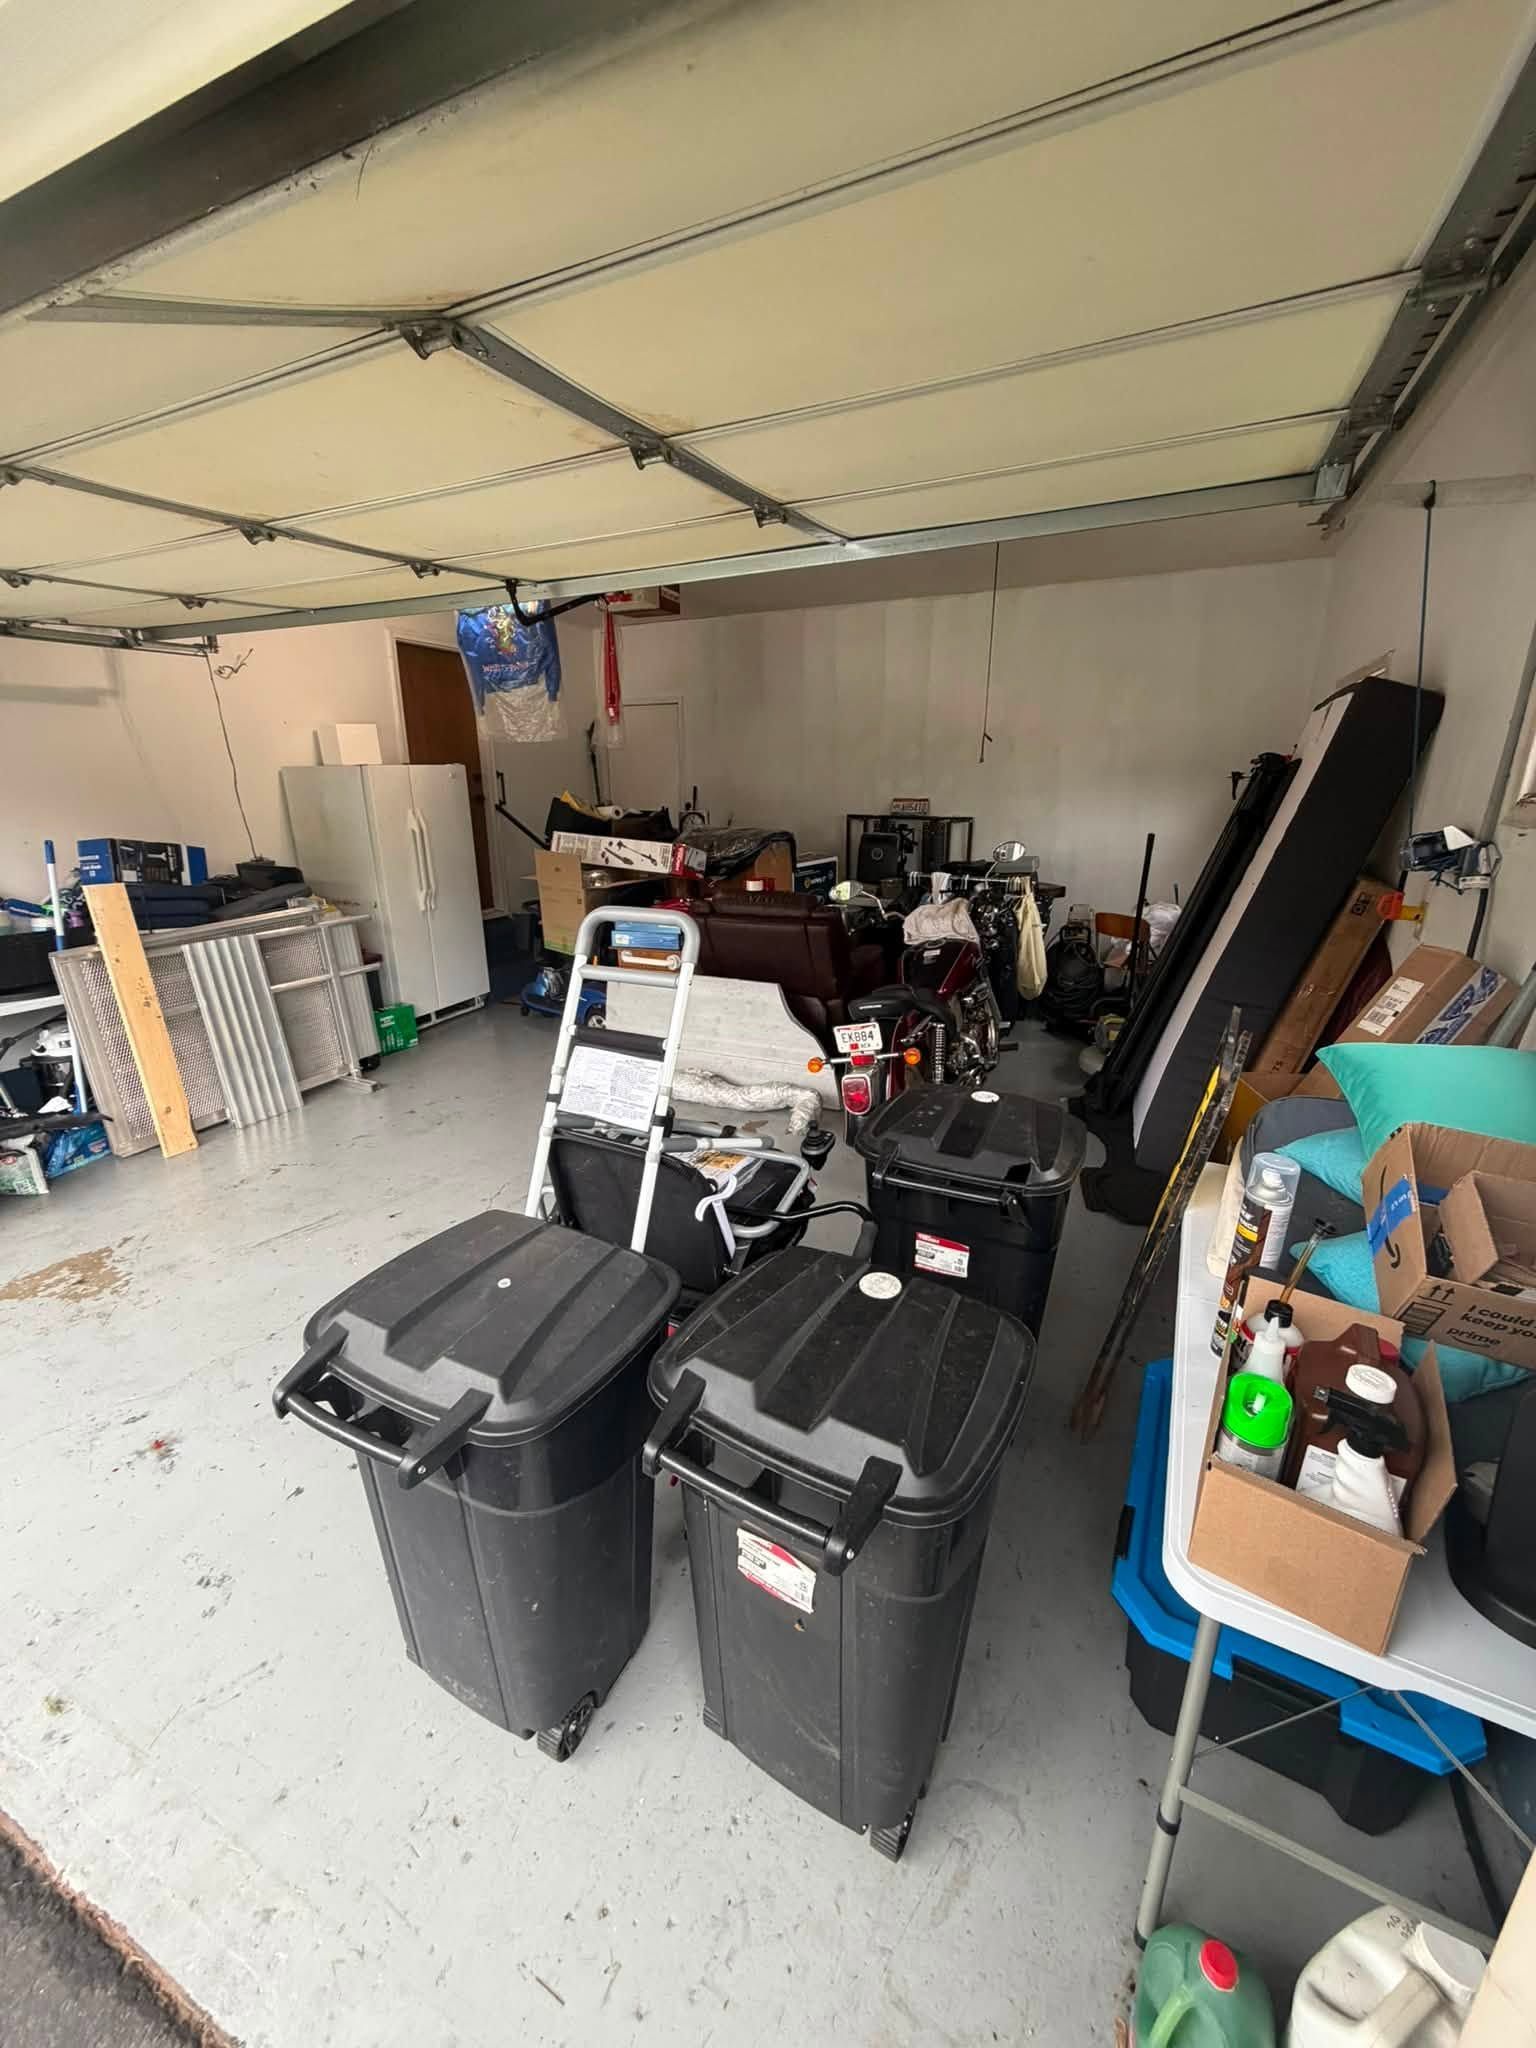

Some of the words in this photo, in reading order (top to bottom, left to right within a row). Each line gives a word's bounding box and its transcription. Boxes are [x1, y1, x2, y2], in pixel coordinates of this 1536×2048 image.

[1461, 1313, 1508, 1331] keep
[1478, 1309, 1535, 1326] could
[1446, 1328, 1501, 1345] prime
